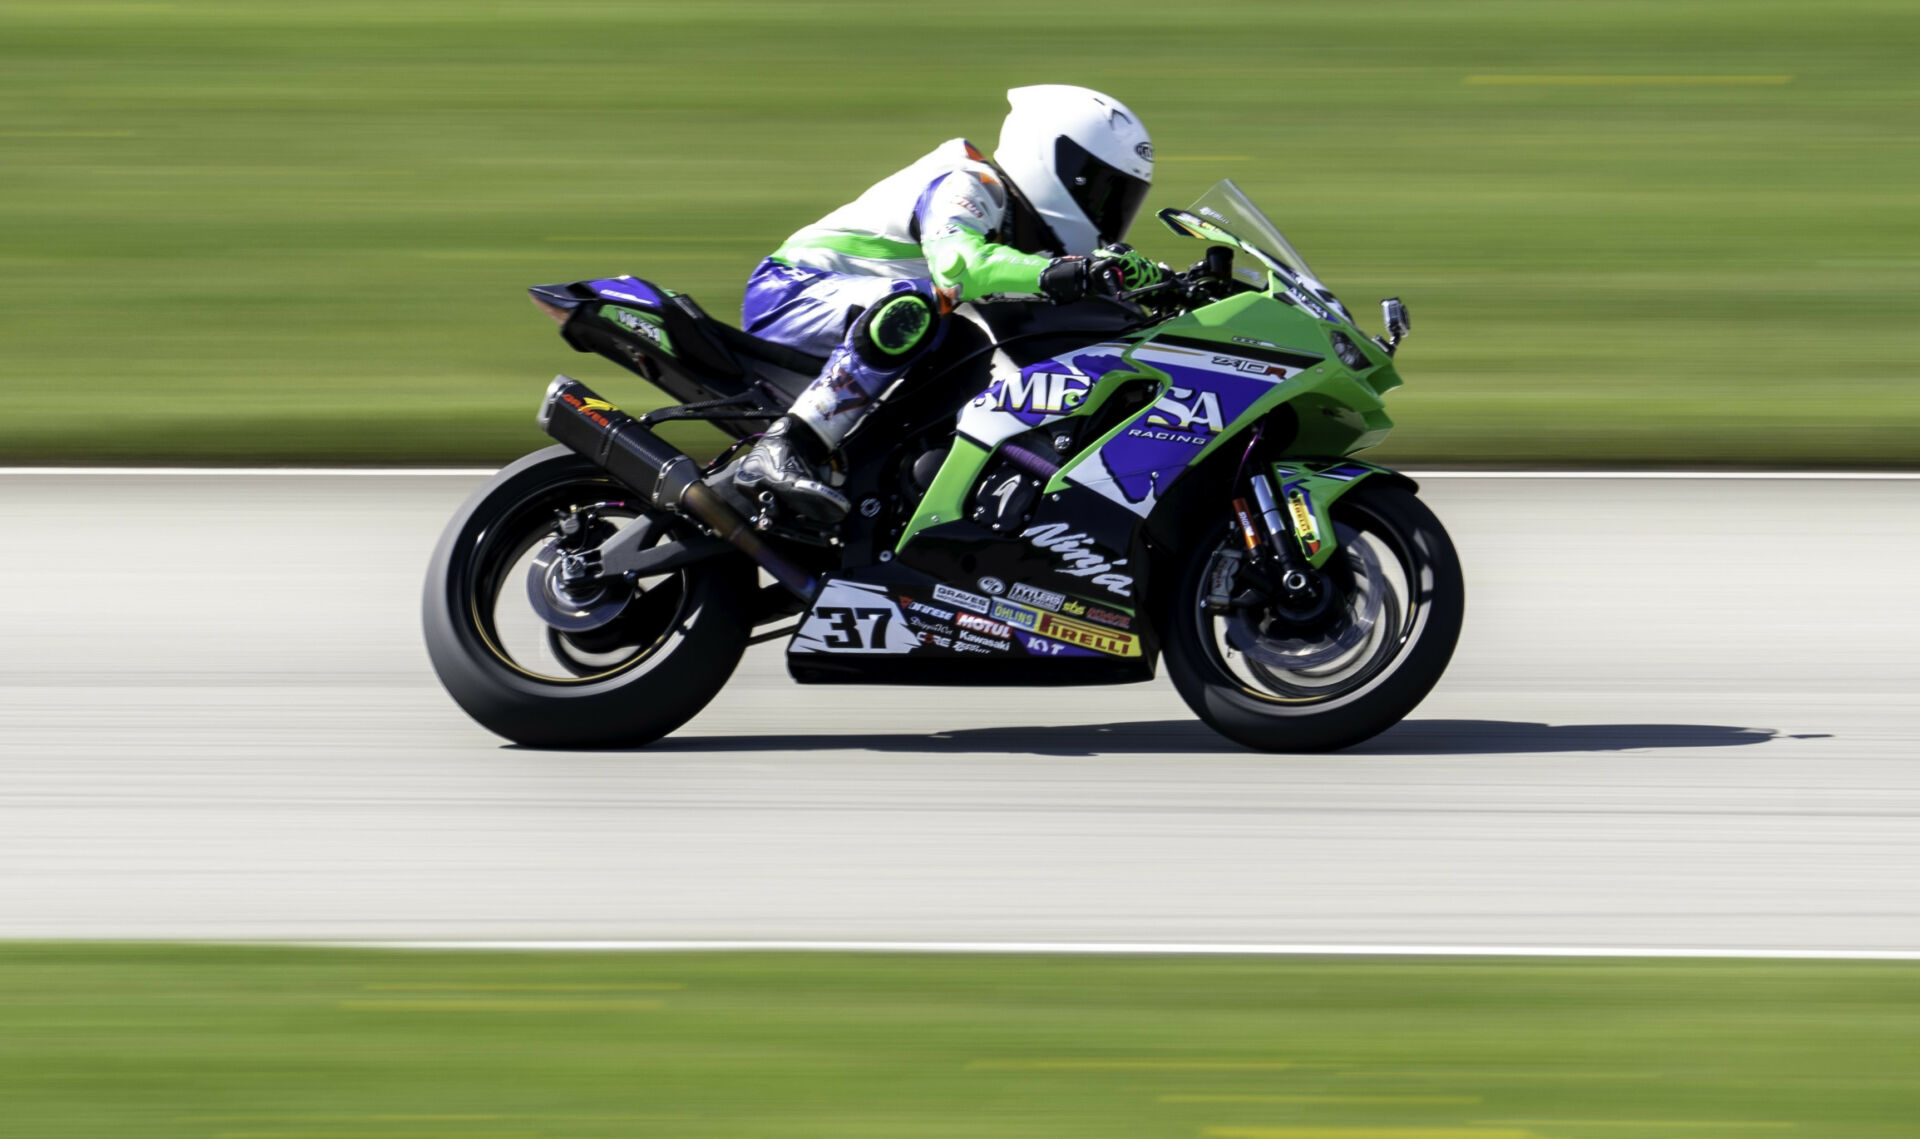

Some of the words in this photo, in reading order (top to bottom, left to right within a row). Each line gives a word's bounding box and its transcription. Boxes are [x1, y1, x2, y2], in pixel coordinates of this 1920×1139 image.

[1128, 429, 1207, 445] RACING
[1019, 522, 1134, 597] Ninja
[938, 587, 987, 606] GRAVES
[816, 606, 893, 649] 37
[957, 613, 1010, 638] MOTUL
[1039, 612, 1132, 655] PIRELLI
[959, 629, 1011, 651] Kawasaki
